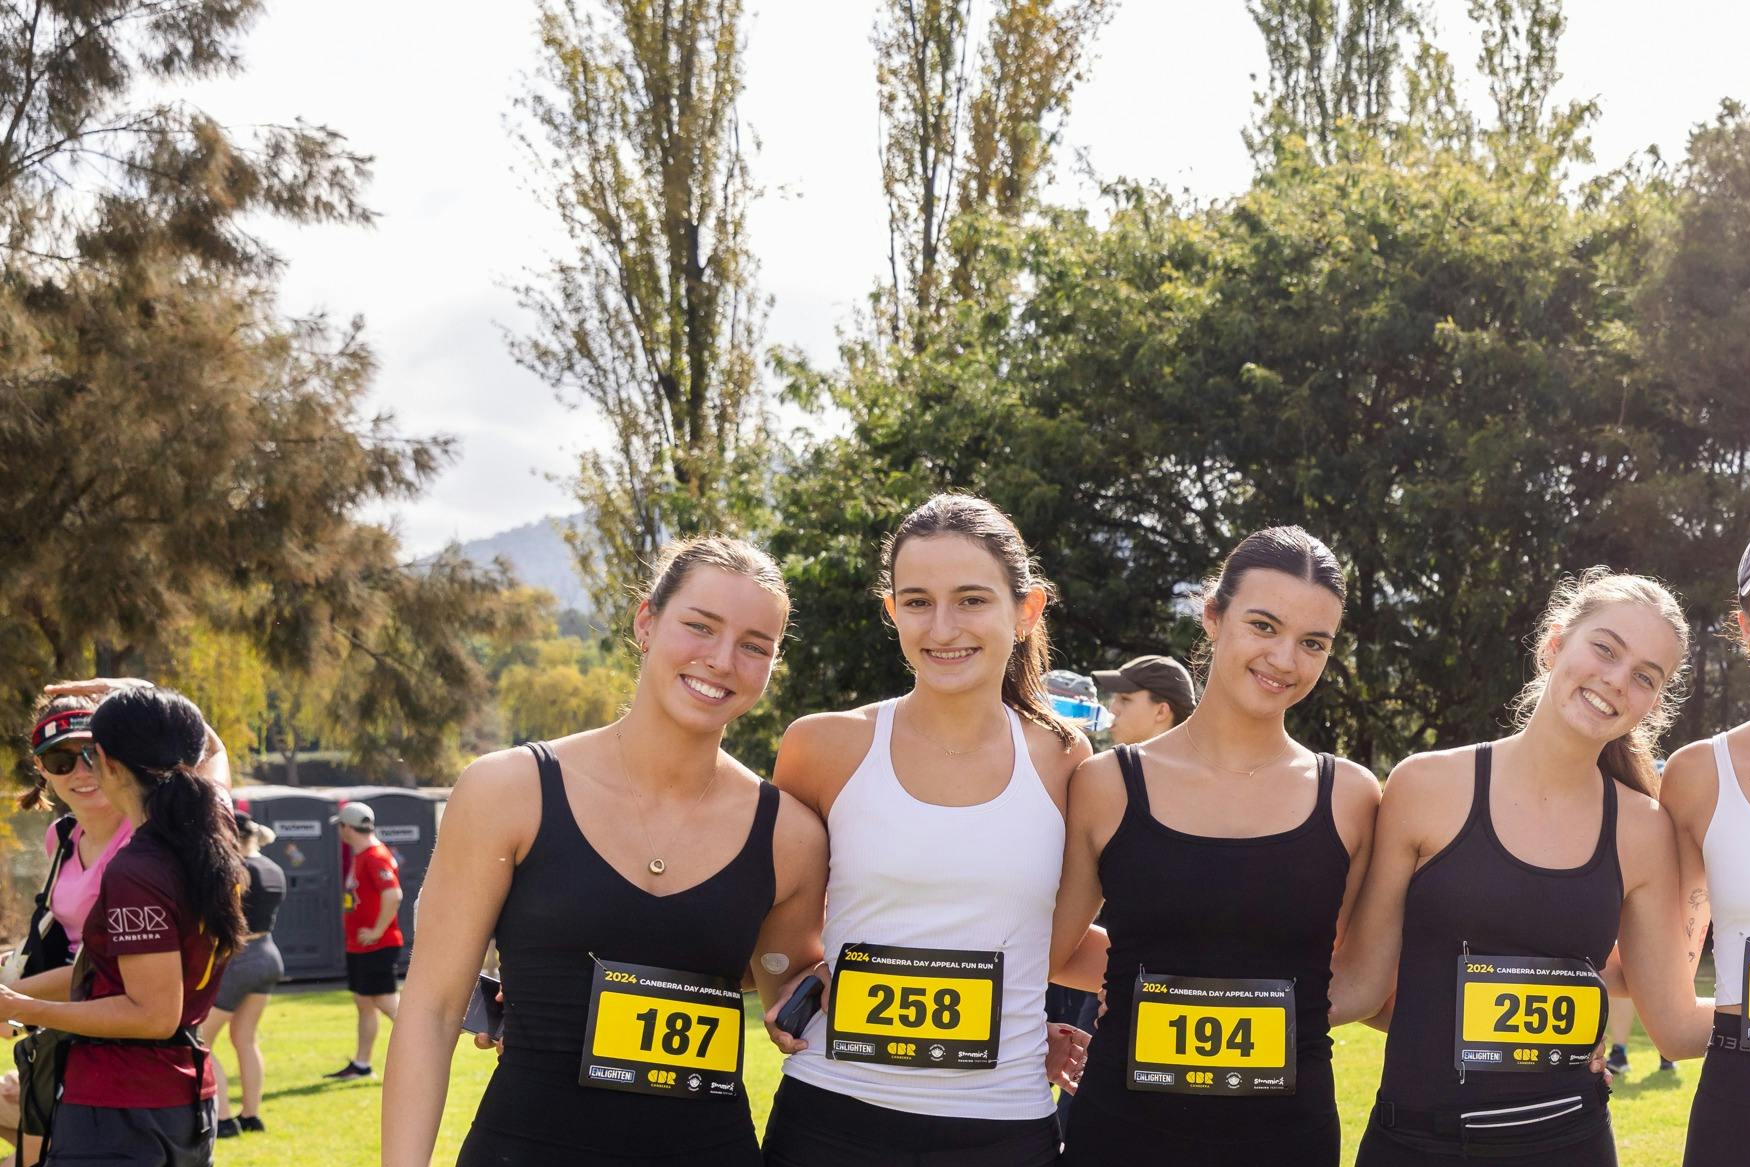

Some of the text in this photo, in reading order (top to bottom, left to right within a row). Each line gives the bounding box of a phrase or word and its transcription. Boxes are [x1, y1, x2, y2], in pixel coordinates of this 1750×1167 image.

[113, 933, 160, 942] CANBERRA
[845, 951, 870, 962] 2024
[872, 957, 912, 967] CANBERRA
[913, 959, 930, 967] DAY
[930, 961, 960, 969] APPEAL
[978, 962, 994, 970] RUN
[1466, 964, 1494, 973] 2024
[1496, 967, 1535, 975] CANBERRA
[1536, 968, 1550, 976] DAY
[605, 971, 638, 984] 2024
[640, 978, 682, 991] CANBERRA
[684, 985, 699, 993] DAY
[699, 987, 722, 996] APPEAL
[1142, 983, 1168, 994] 2024
[1170, 988, 1208, 997] CANBERRA
[866, 984, 961, 1029] 258
[1493, 993, 1576, 1035] 259
[636, 1008, 720, 1059] 187
[1168, 1015, 1255, 1058] 194
[835, 1041, 872, 1053] ENLIGHTEN
[1464, 1051, 1500, 1061] ENLIGHTEN
[591, 1067, 632, 1081] ENLIGHTEN
[1136, 1072, 1171, 1083] ENLIGHTEN
